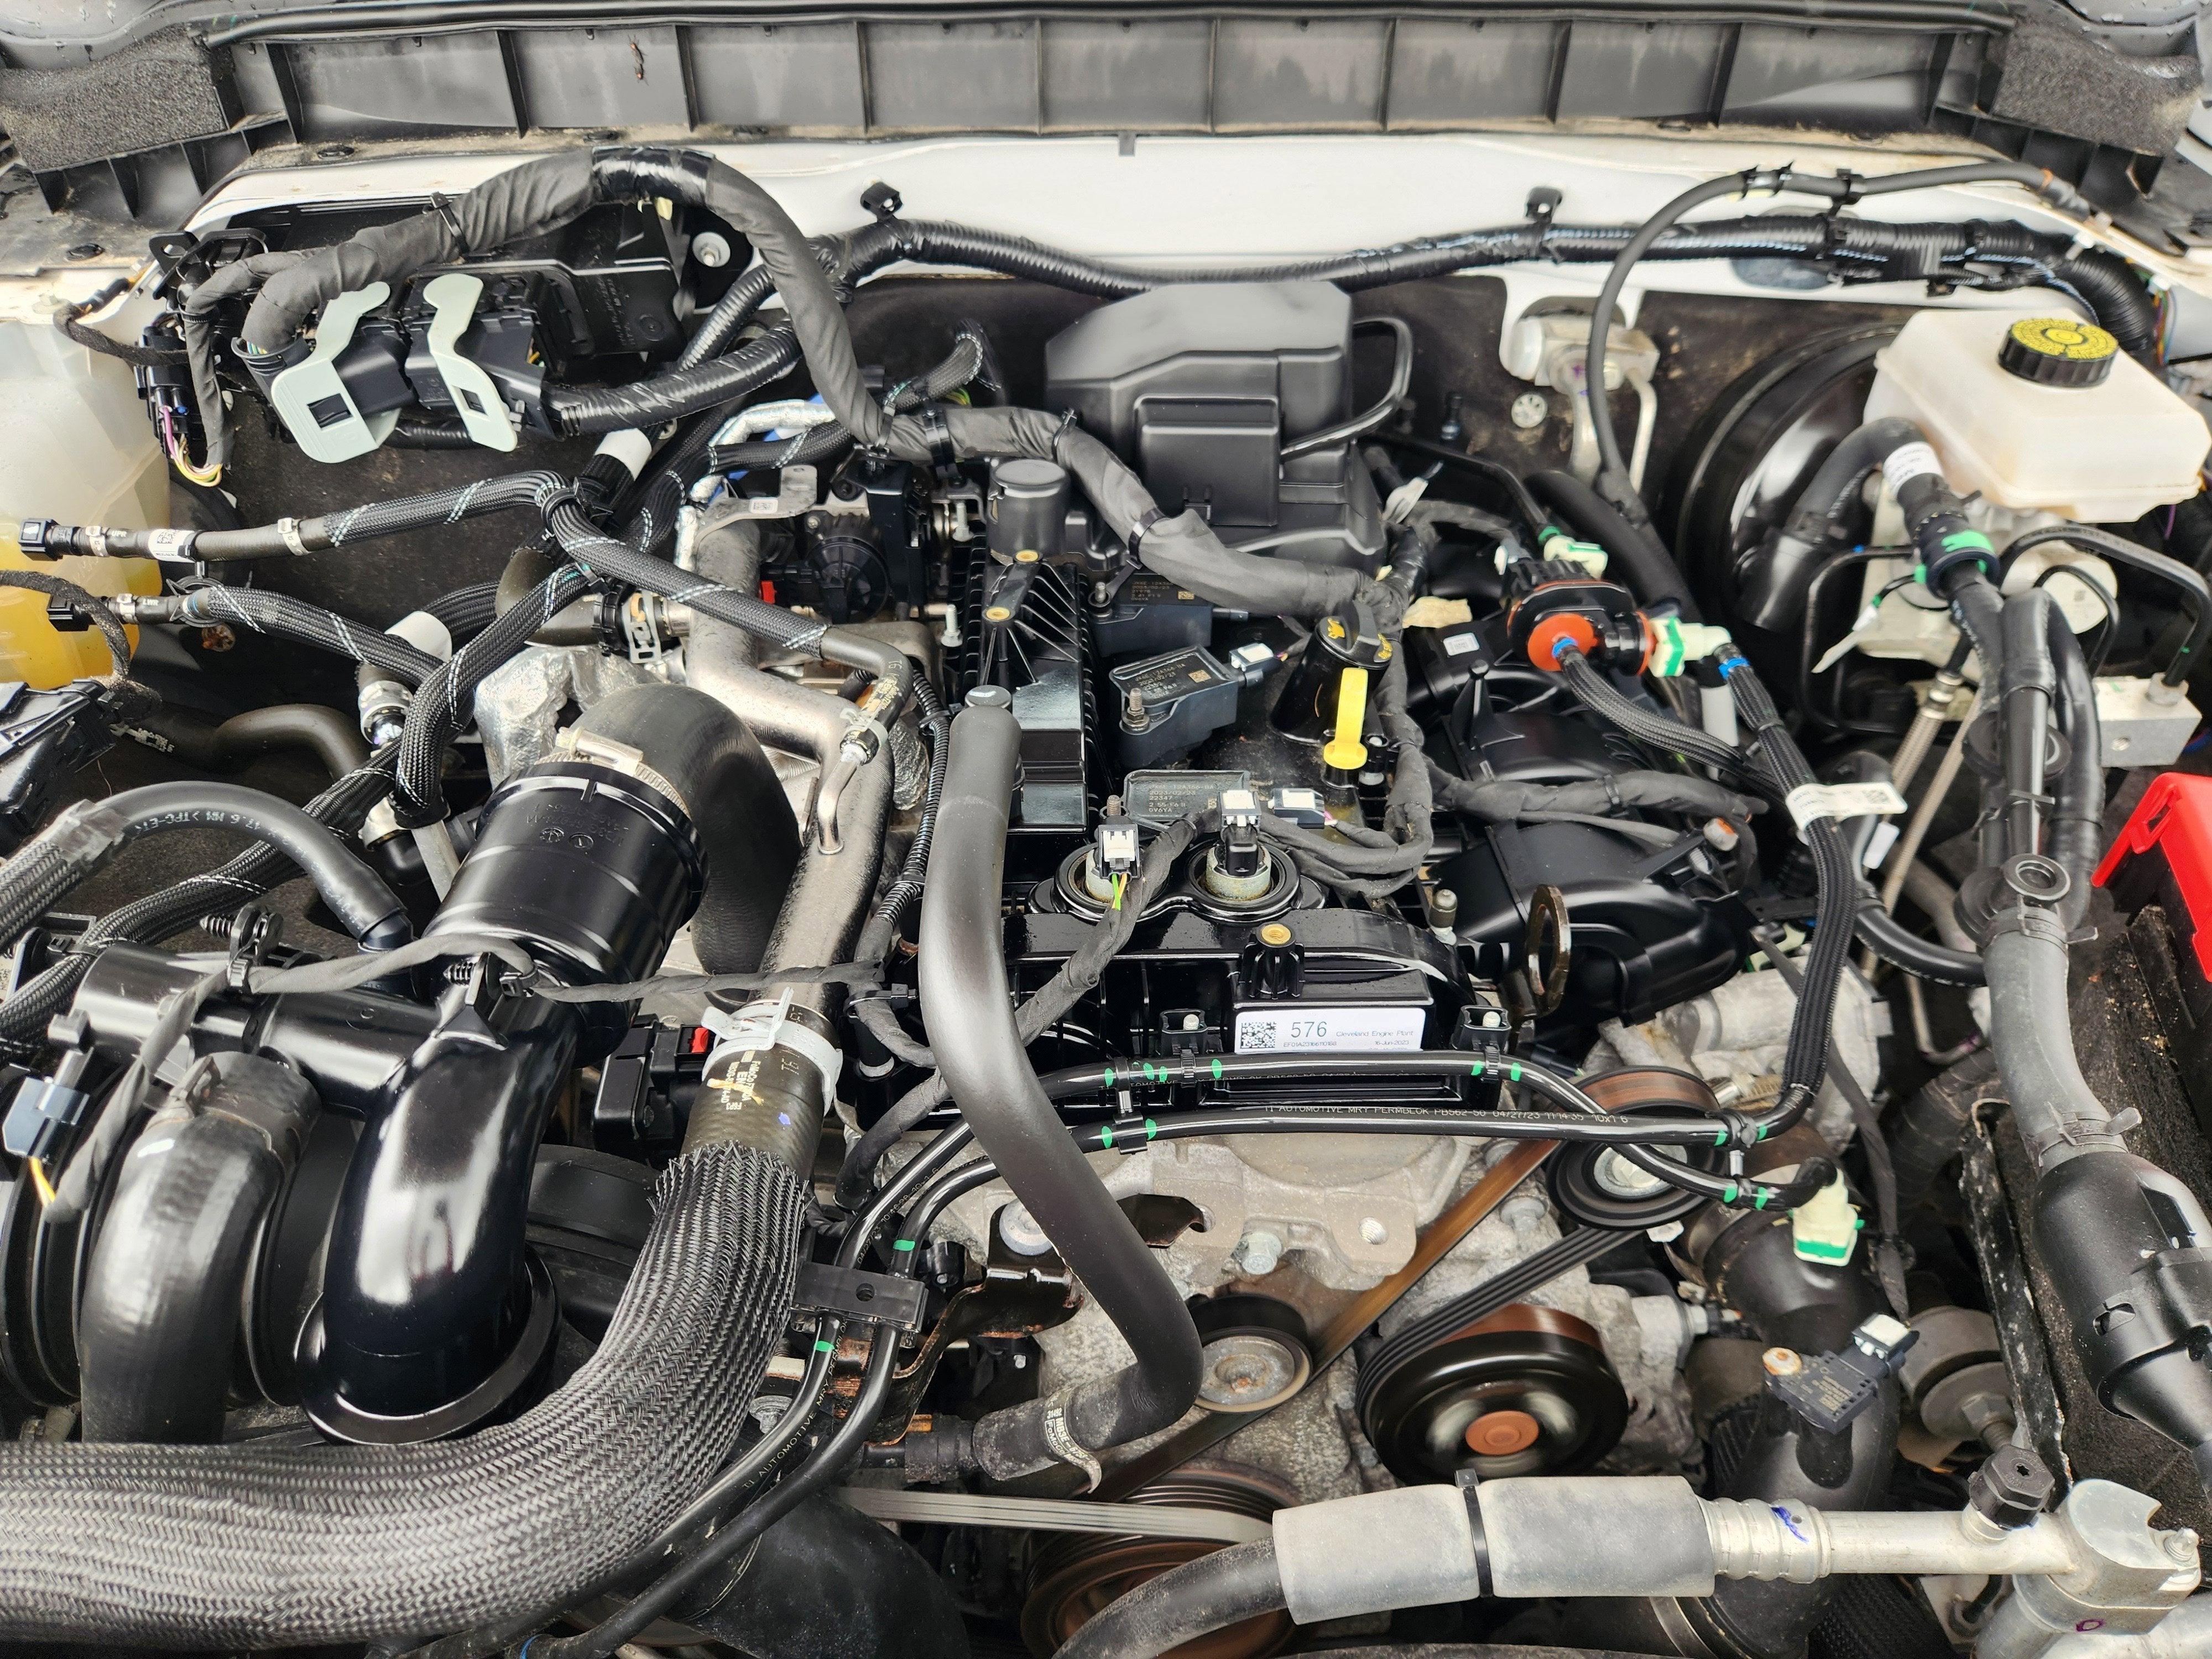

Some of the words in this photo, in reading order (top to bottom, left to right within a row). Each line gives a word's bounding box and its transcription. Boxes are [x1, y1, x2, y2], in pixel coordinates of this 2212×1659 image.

[1291, 1021, 1327, 1037] 576
[759, 1411, 817, 1477] AUTOMOTIVE
[816, 1378, 830, 1406] MRY
[1046, 1421, 1066, 1455] FoMoCo
